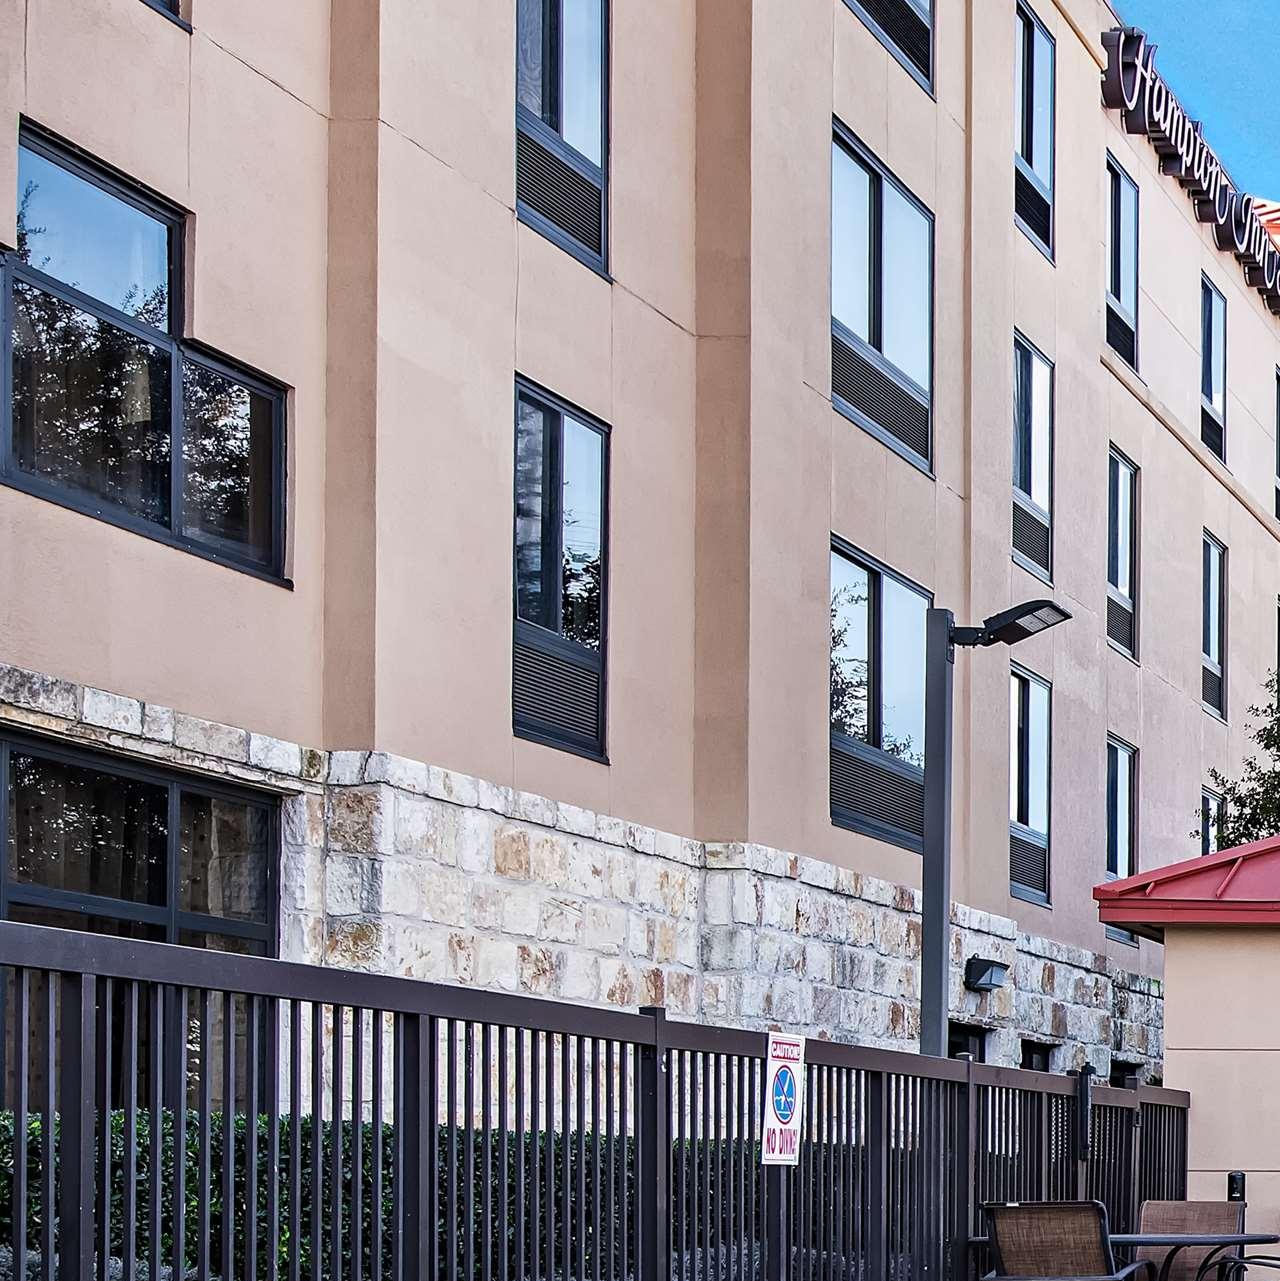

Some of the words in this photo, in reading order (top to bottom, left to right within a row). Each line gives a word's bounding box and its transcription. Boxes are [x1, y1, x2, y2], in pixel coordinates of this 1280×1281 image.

[1116, 30, 1229, 226] Hampton
[1232, 193, 1277, 289] Inn
[766, 1128, 776, 1155] NO
